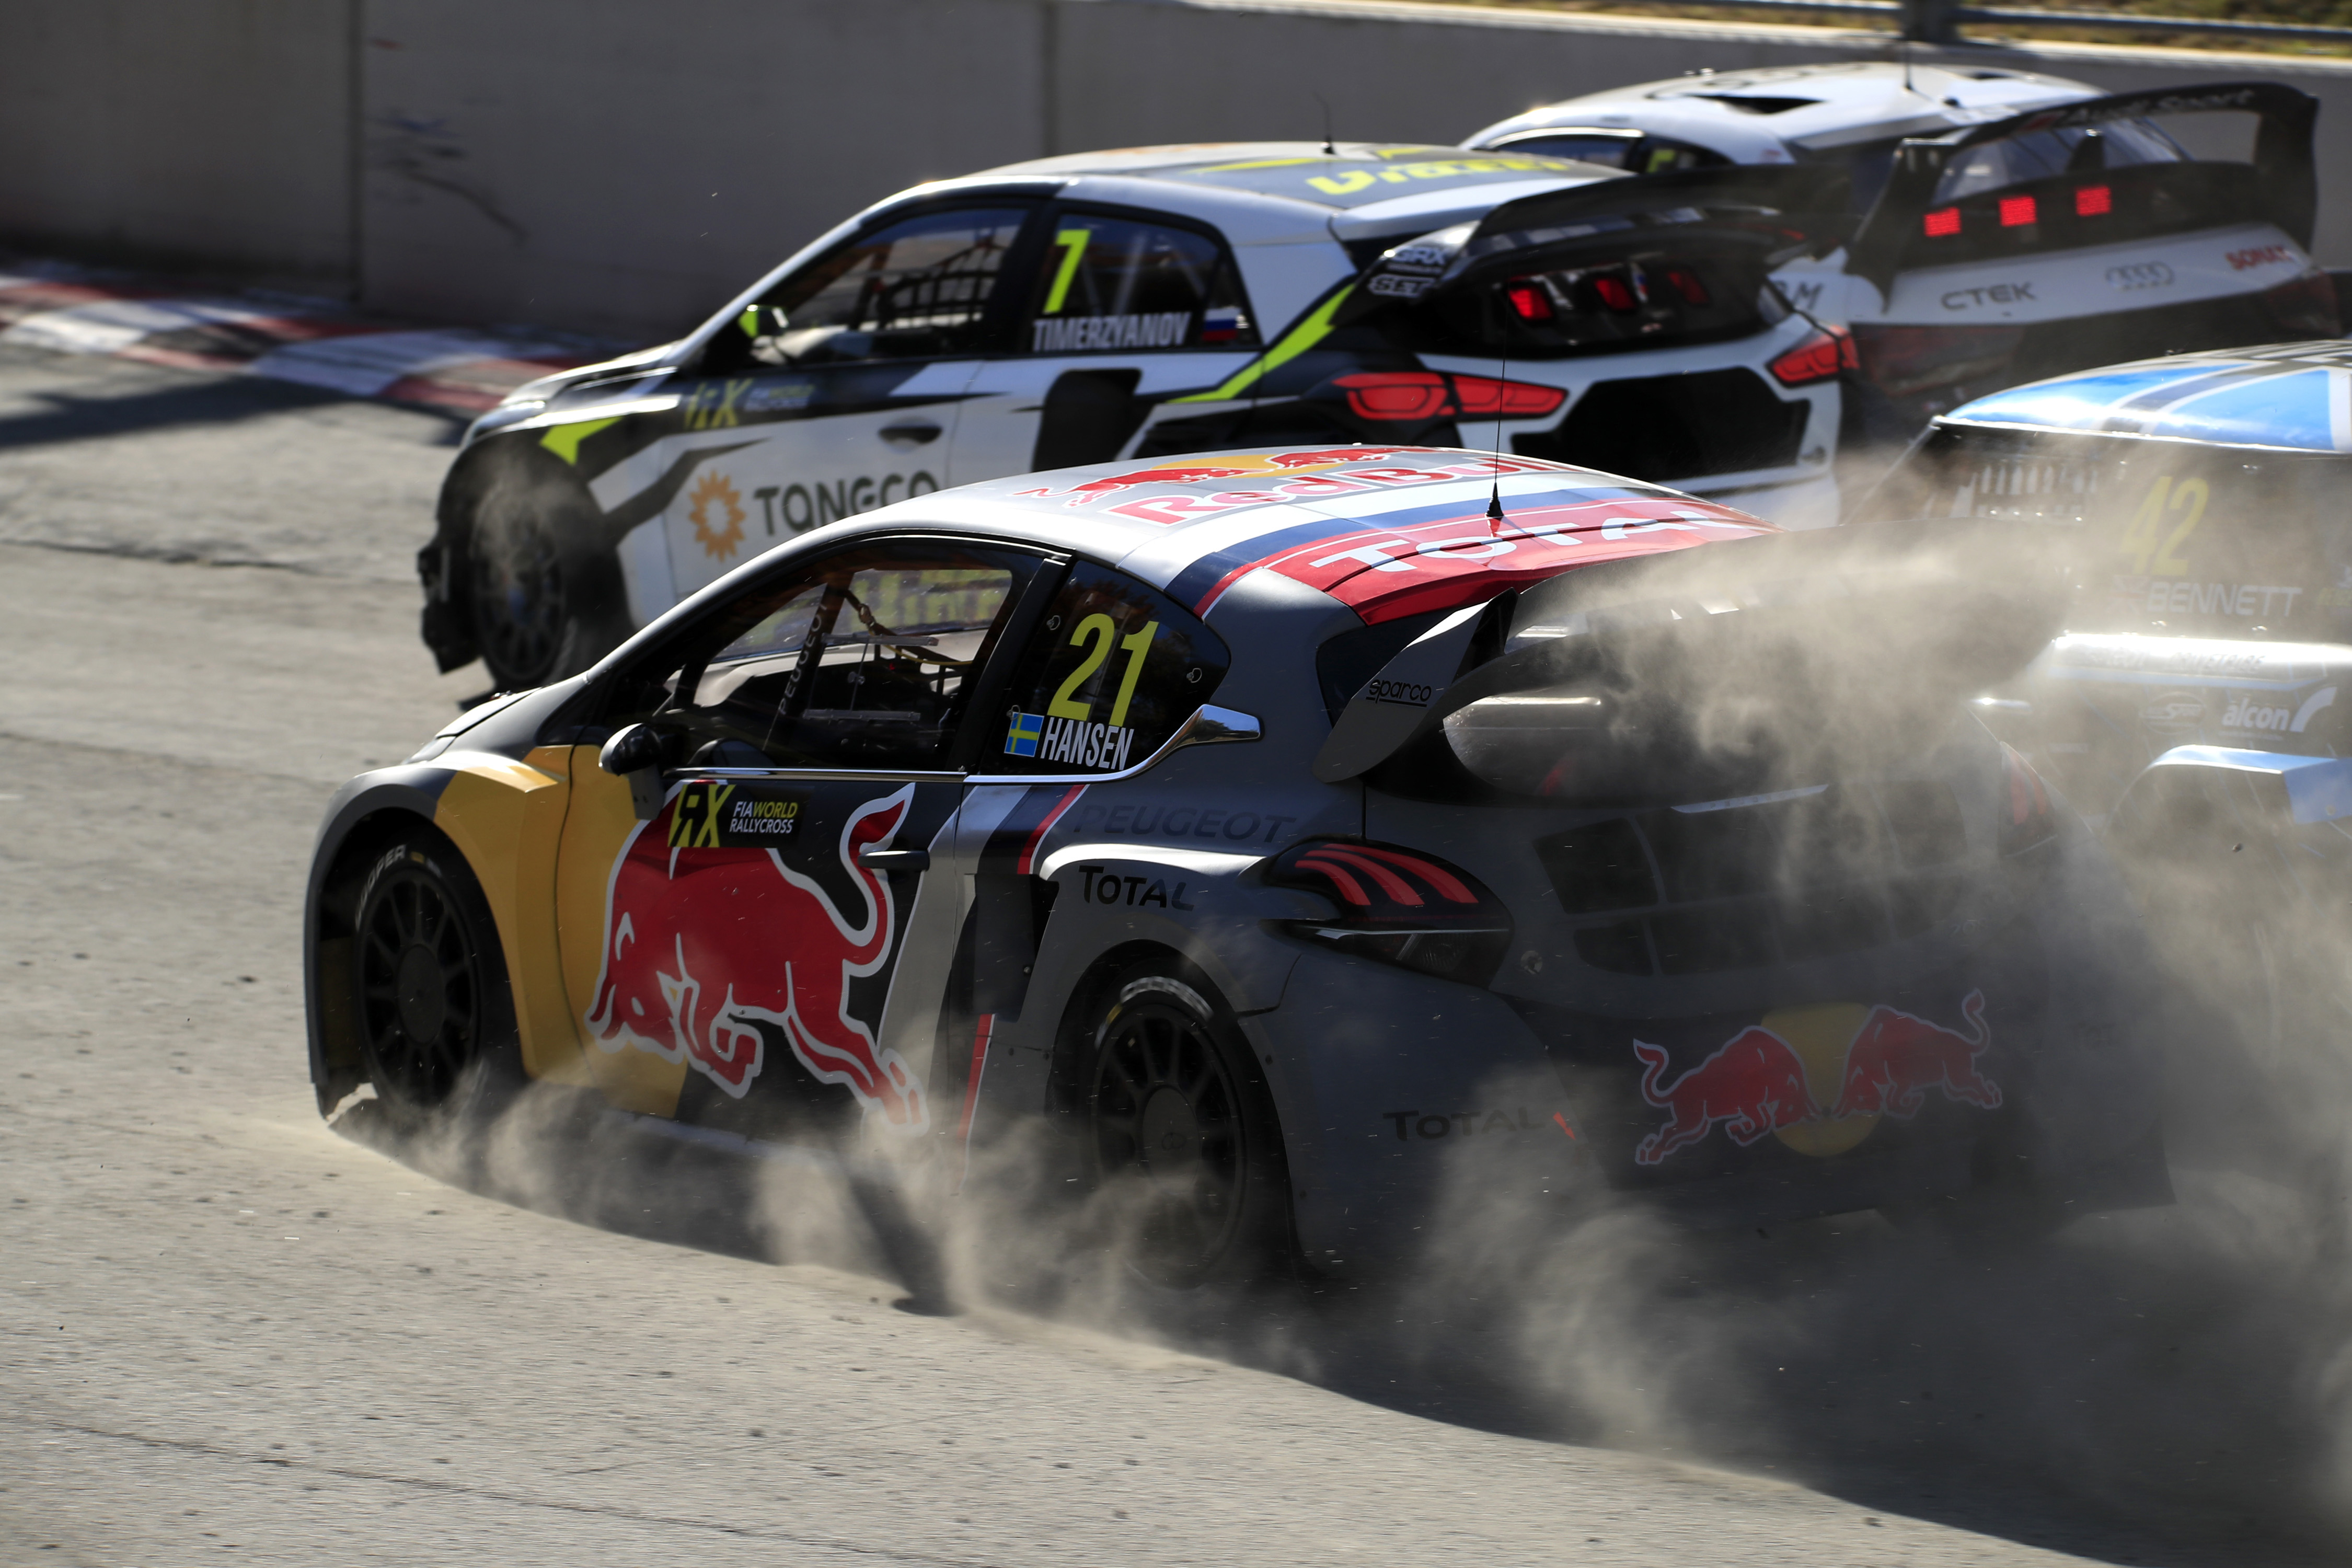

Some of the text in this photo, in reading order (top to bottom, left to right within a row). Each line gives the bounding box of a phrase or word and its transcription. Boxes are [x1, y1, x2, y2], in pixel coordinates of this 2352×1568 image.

[1045, 229, 1091, 312] 7
[1942, 282, 2036, 310] CTEK
[1033, 312, 1191, 352] TIMERZYANOV
[2120, 476, 2208, 576] 42
[2147, 582, 2302, 617] BENNETT
[1047, 614, 1159, 727] 21
[1367, 677, 1432, 704] sparco
[2222, 697, 2290, 731] alcon
[1040, 717, 1134, 770] HANSEN
[730, 817, 794, 834] RALLYCROSS
[1073, 804, 1296, 843] PEUGEOT
[1078, 865, 1194, 912] TOTAL
[1382, 1106, 1546, 1142] TOTAL
